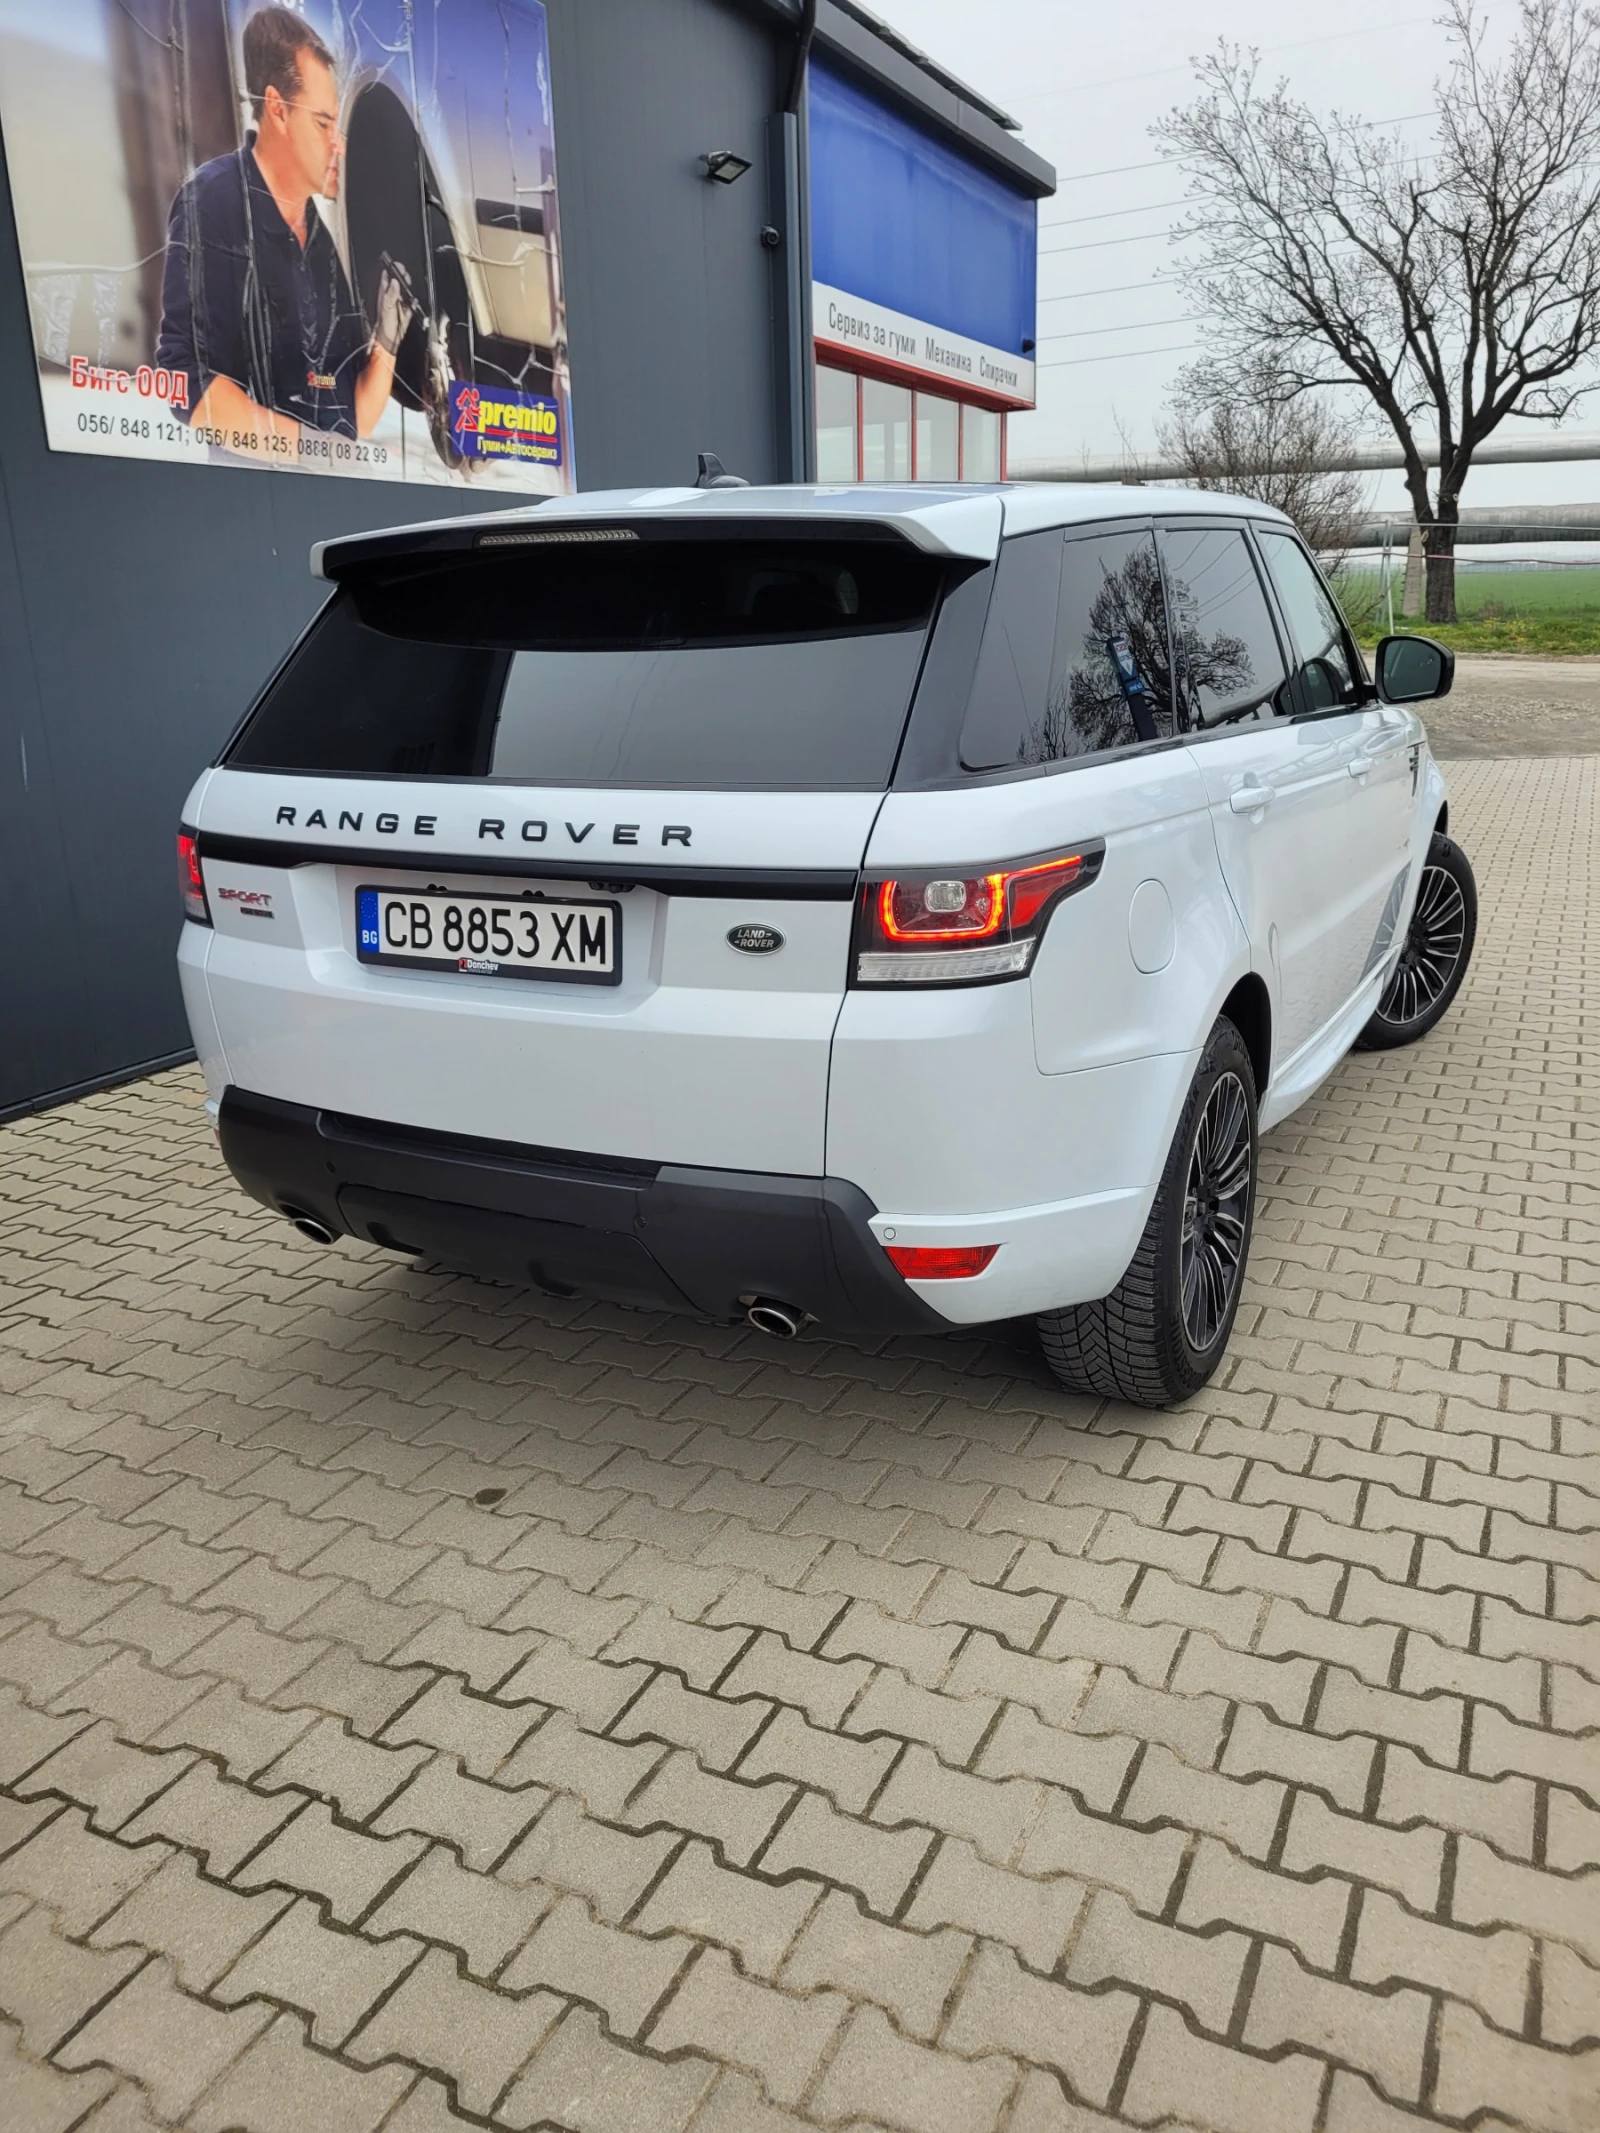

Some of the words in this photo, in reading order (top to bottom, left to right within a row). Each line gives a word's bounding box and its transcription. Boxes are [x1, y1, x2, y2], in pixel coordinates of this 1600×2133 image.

[828, 303, 870, 340] Сервиз
[873, 326, 886, 346] за
[889, 332, 916, 357] гуми
[925, 337, 972, 373] Механика
[979, 356, 1018, 387] Спирачки
[71, 356, 129, 394] Бигс
[137, 365, 189, 409] ООД
[478, 400, 557, 435] premio
[77, 413, 115, 435] 056/
[120, 418, 150, 439] 848
[156, 423, 190, 446] 121;
[195, 427, 228, 448] 056/
[232, 431, 258, 450] 848
[263, 436, 293, 457] 125;
[336, 443, 351, 460] 08
[355, 446, 369, 461] 22
[373, 448, 388, 463] 99
[275, 806, 438, 836] RANGE
[478, 818, 693, 848] ROVER
[361, 930, 378, 945] BG
[384, 901, 432, 949] CB
[443, 905, 541, 959] 8853
[551, 912, 607, 964] XM
[737, 930, 765, 939] LAND
[740, 938, 774, 948] ROVER
[467, 959, 499, 971] Donchev
